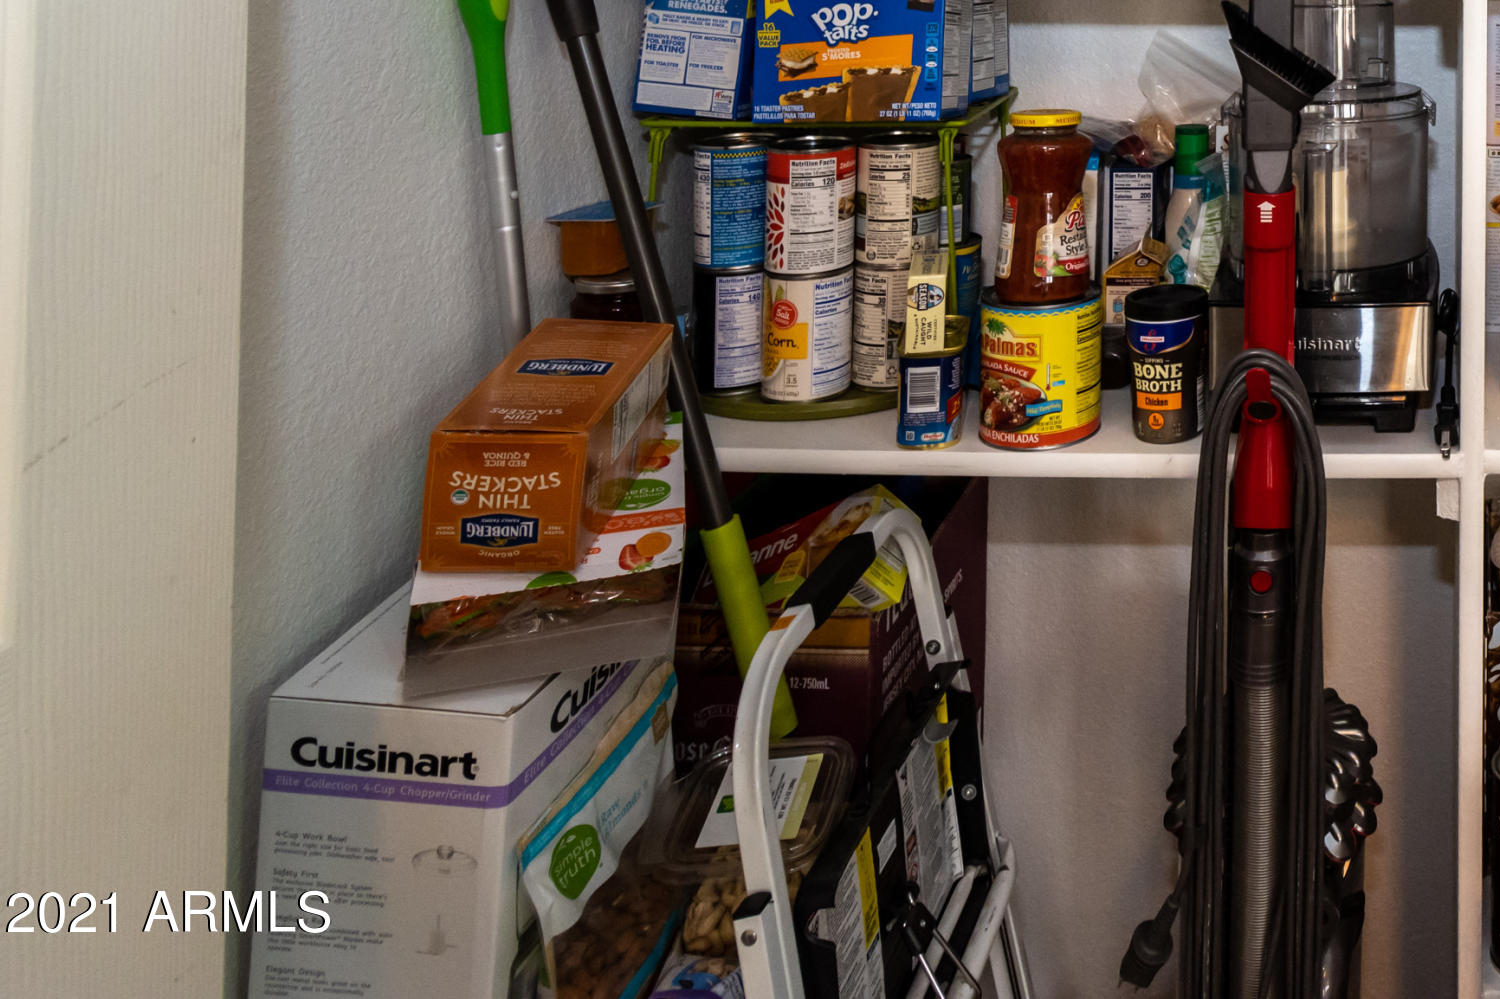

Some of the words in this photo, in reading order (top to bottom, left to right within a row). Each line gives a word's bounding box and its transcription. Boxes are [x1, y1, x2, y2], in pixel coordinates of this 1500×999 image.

[668, 1, 728, 14] RENEGADES.
[763, 23, 774, 31] 16
[824, 22, 870, 45] tarts
[645, 44, 685, 54] HEATING
[662, 39, 685, 47] BEFORE
[822, 51, 861, 61] S'MORES
[791, 160, 818, 168] Nutrition
[819, 158, 836, 166] Facts
[822, 177, 835, 185] 120
[902, 172, 910, 180] 25
[815, 280, 841, 291] Nutrition
[748, 293, 761, 302] 140
[878, 297, 886, 305] 30
[918, 283, 928, 310] SEASON
[775, 308, 791, 321] Salt
[815, 307, 837, 315] Calories
[767, 333, 795, 349] Corn
[985, 334, 1038, 358] Palmas
[1295, 335, 1362, 351] uisinart
[527, 361, 605, 373] LUNDBERG
[1003, 363, 1029, 378] SAUCE
[1133, 361, 1183, 379] BONE
[1135, 378, 1182, 393] BROTH
[1144, 397, 1169, 407] Chicken
[489, 407, 564, 415] STACKERS
[503, 413, 539, 421] THIN
[991, 430, 1040, 444] ENCHILADAS
[483, 451, 521, 460] QUINOA
[508, 460, 527, 468] RED
[448, 470, 561, 491] STACKERS
[478, 493, 532, 509] THIN
[466, 521, 534, 539] LUNDBERG
[478, 549, 520, 558] ORGANIC
[789, 677, 830, 690] 12-750mL
[290, 736, 477, 780] Cuisinart
[523, 757, 547, 785] Elite
[274, 775, 300, 787] Elite
[303, 778, 358, 792] Collection
[362, 783, 395, 796] 4-Cup
[400, 785, 492, 803] Chopper/Grinder
[553, 835, 592, 874] simple
[557, 848, 597, 889] truth
